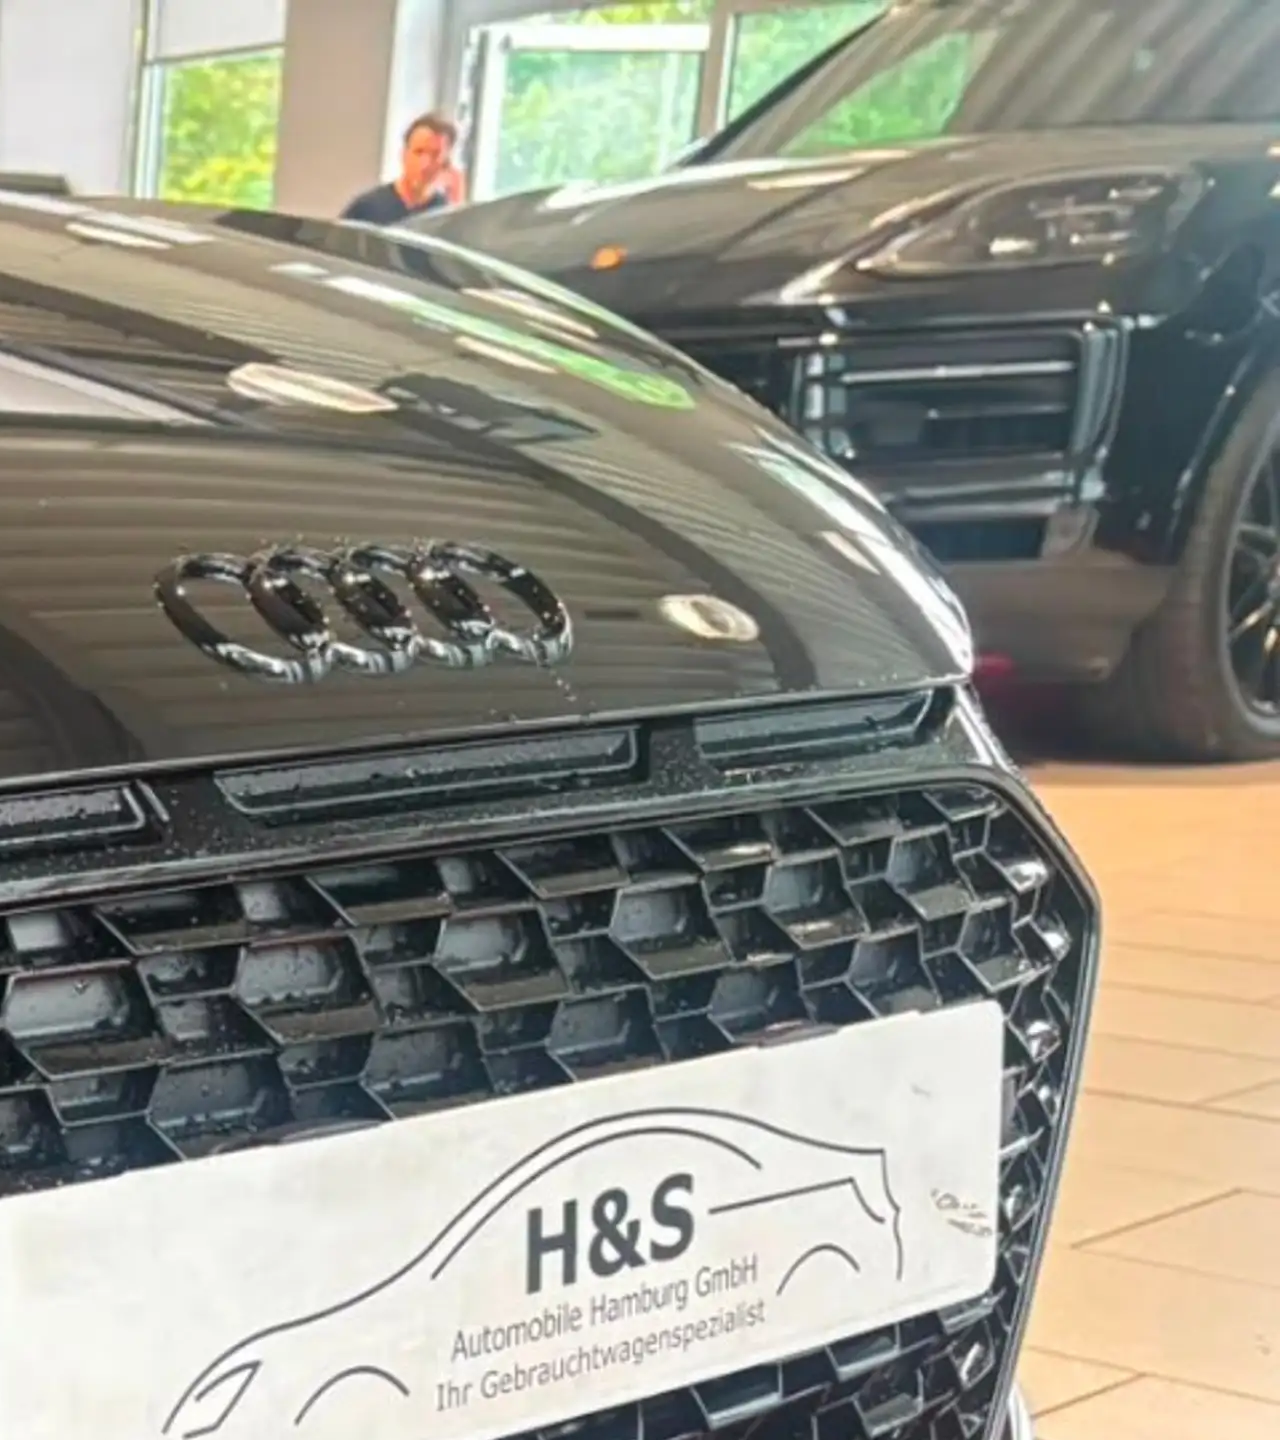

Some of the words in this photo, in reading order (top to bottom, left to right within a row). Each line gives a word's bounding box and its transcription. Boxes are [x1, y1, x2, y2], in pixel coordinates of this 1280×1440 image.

[526, 1172, 695, 1295] H&S
[436, 1382, 474, 1411] Ihr
[480, 1300, 766, 1399] Gebrauchtwagenspezialist
[451, 1303, 583, 1363] Automobile
[590, 1278, 688, 1326] Hamburg
[695, 1253, 758, 1297] GmbH
